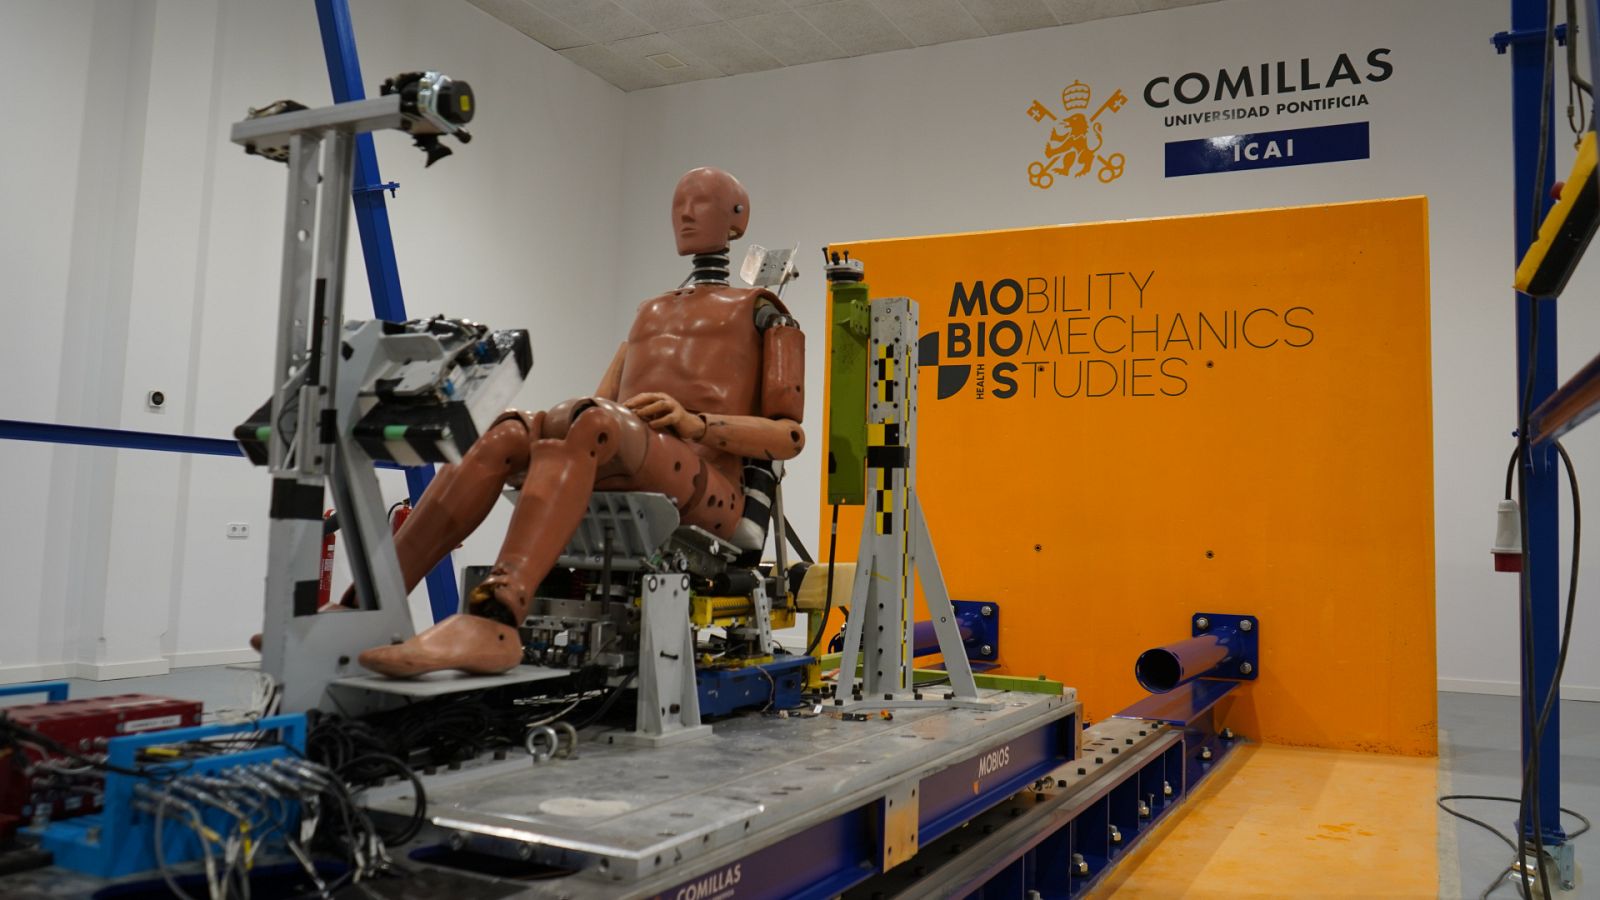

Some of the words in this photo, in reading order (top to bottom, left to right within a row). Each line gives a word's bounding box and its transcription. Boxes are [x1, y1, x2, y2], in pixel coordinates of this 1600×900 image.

[1143, 48, 1394, 108] COMILLAS
[1164, 105, 1270, 127] UNIVERSIDAD
[1276, 93, 1369, 115] PONTIFICIA
[1234, 139, 1294, 162] ICAI
[948, 270, 1155, 317] MOBILITY
[947, 306, 1314, 358] BIOMECHANICS
[976, 364, 985, 400] HEALTH
[991, 357, 1188, 399] STUDIES
[978, 746, 1010, 778] MOBIOS
